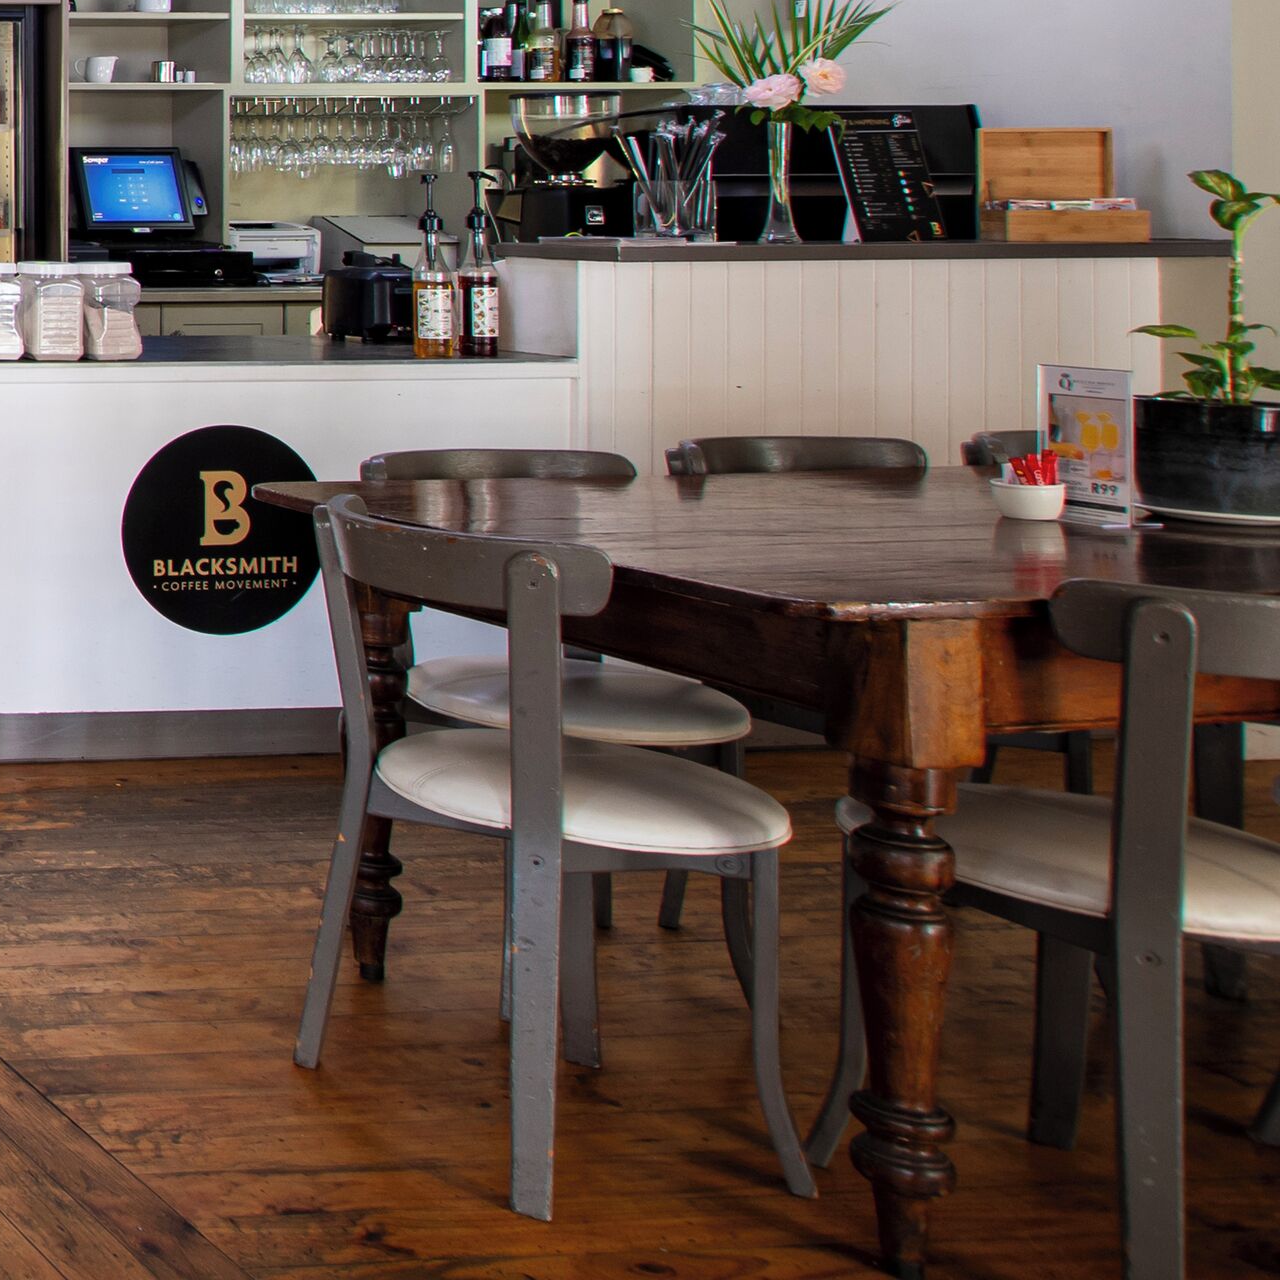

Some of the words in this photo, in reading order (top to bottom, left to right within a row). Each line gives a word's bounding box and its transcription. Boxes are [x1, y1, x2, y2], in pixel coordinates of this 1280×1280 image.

[1091, 482, 1118, 495] R99
[199, 470, 251, 546] B
[153, 556, 298, 576] BLACKSMITH
[162, 581, 209, 592] COFFEE
[215, 579, 288, 590] MOVEMENT
